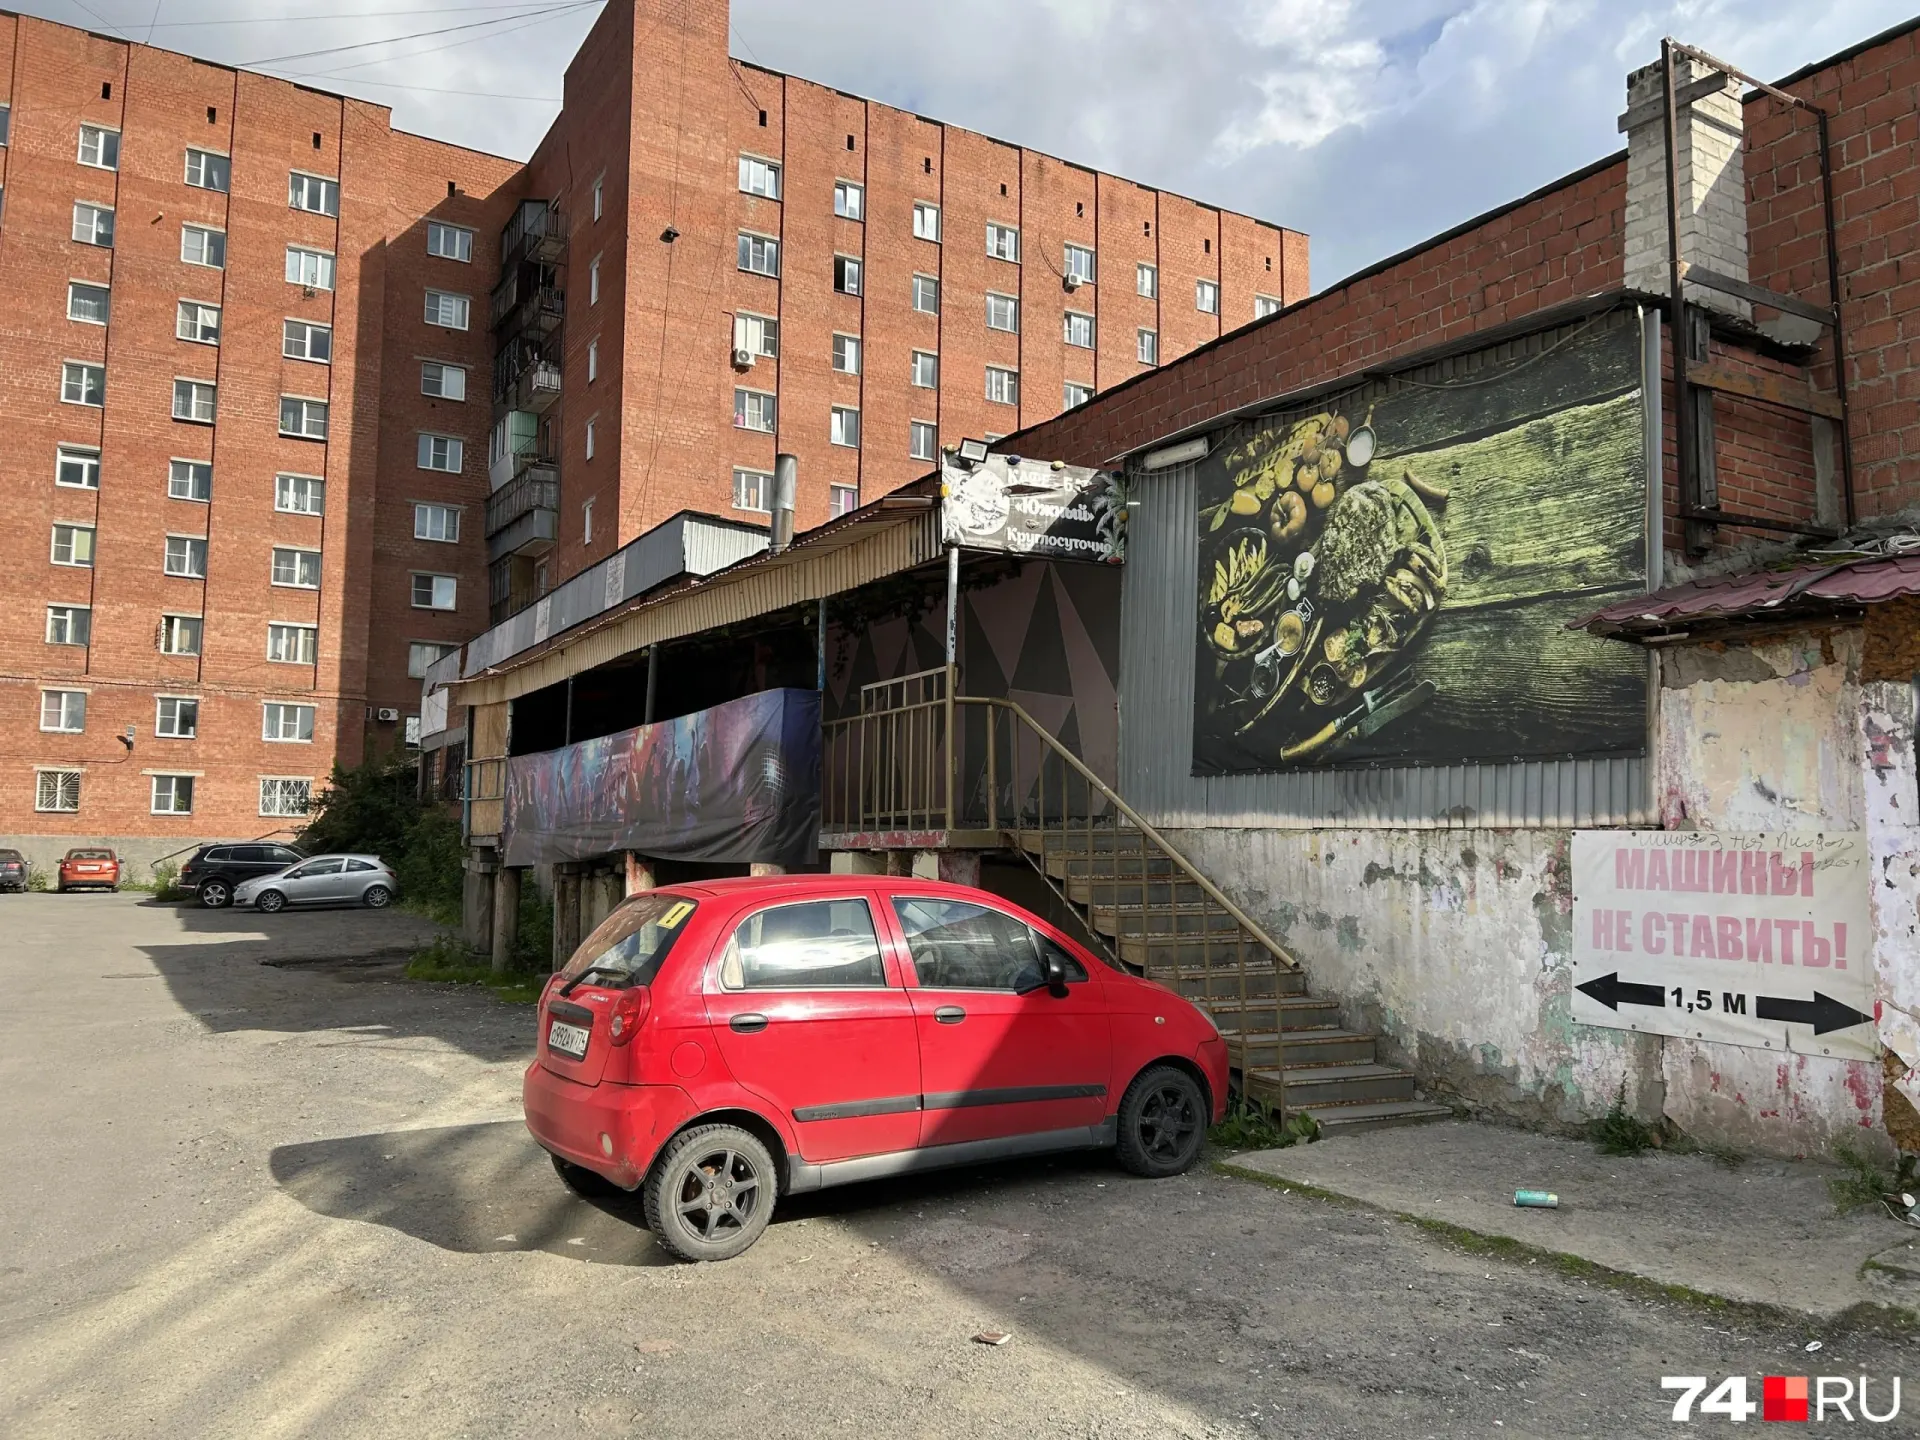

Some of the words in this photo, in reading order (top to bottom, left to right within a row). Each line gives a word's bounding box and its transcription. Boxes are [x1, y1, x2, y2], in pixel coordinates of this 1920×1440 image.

[1006, 527, 1113, 553] Круглосуточно
[1614, 848, 1814, 897] МАШИНЫ
[1592, 908, 1633, 952] НЕ
[1642, 911, 1848, 970] СТАВИТЬ!
[1670, 987, 1712, 1014] 1,5
[1722, 992, 1747, 1015] М
